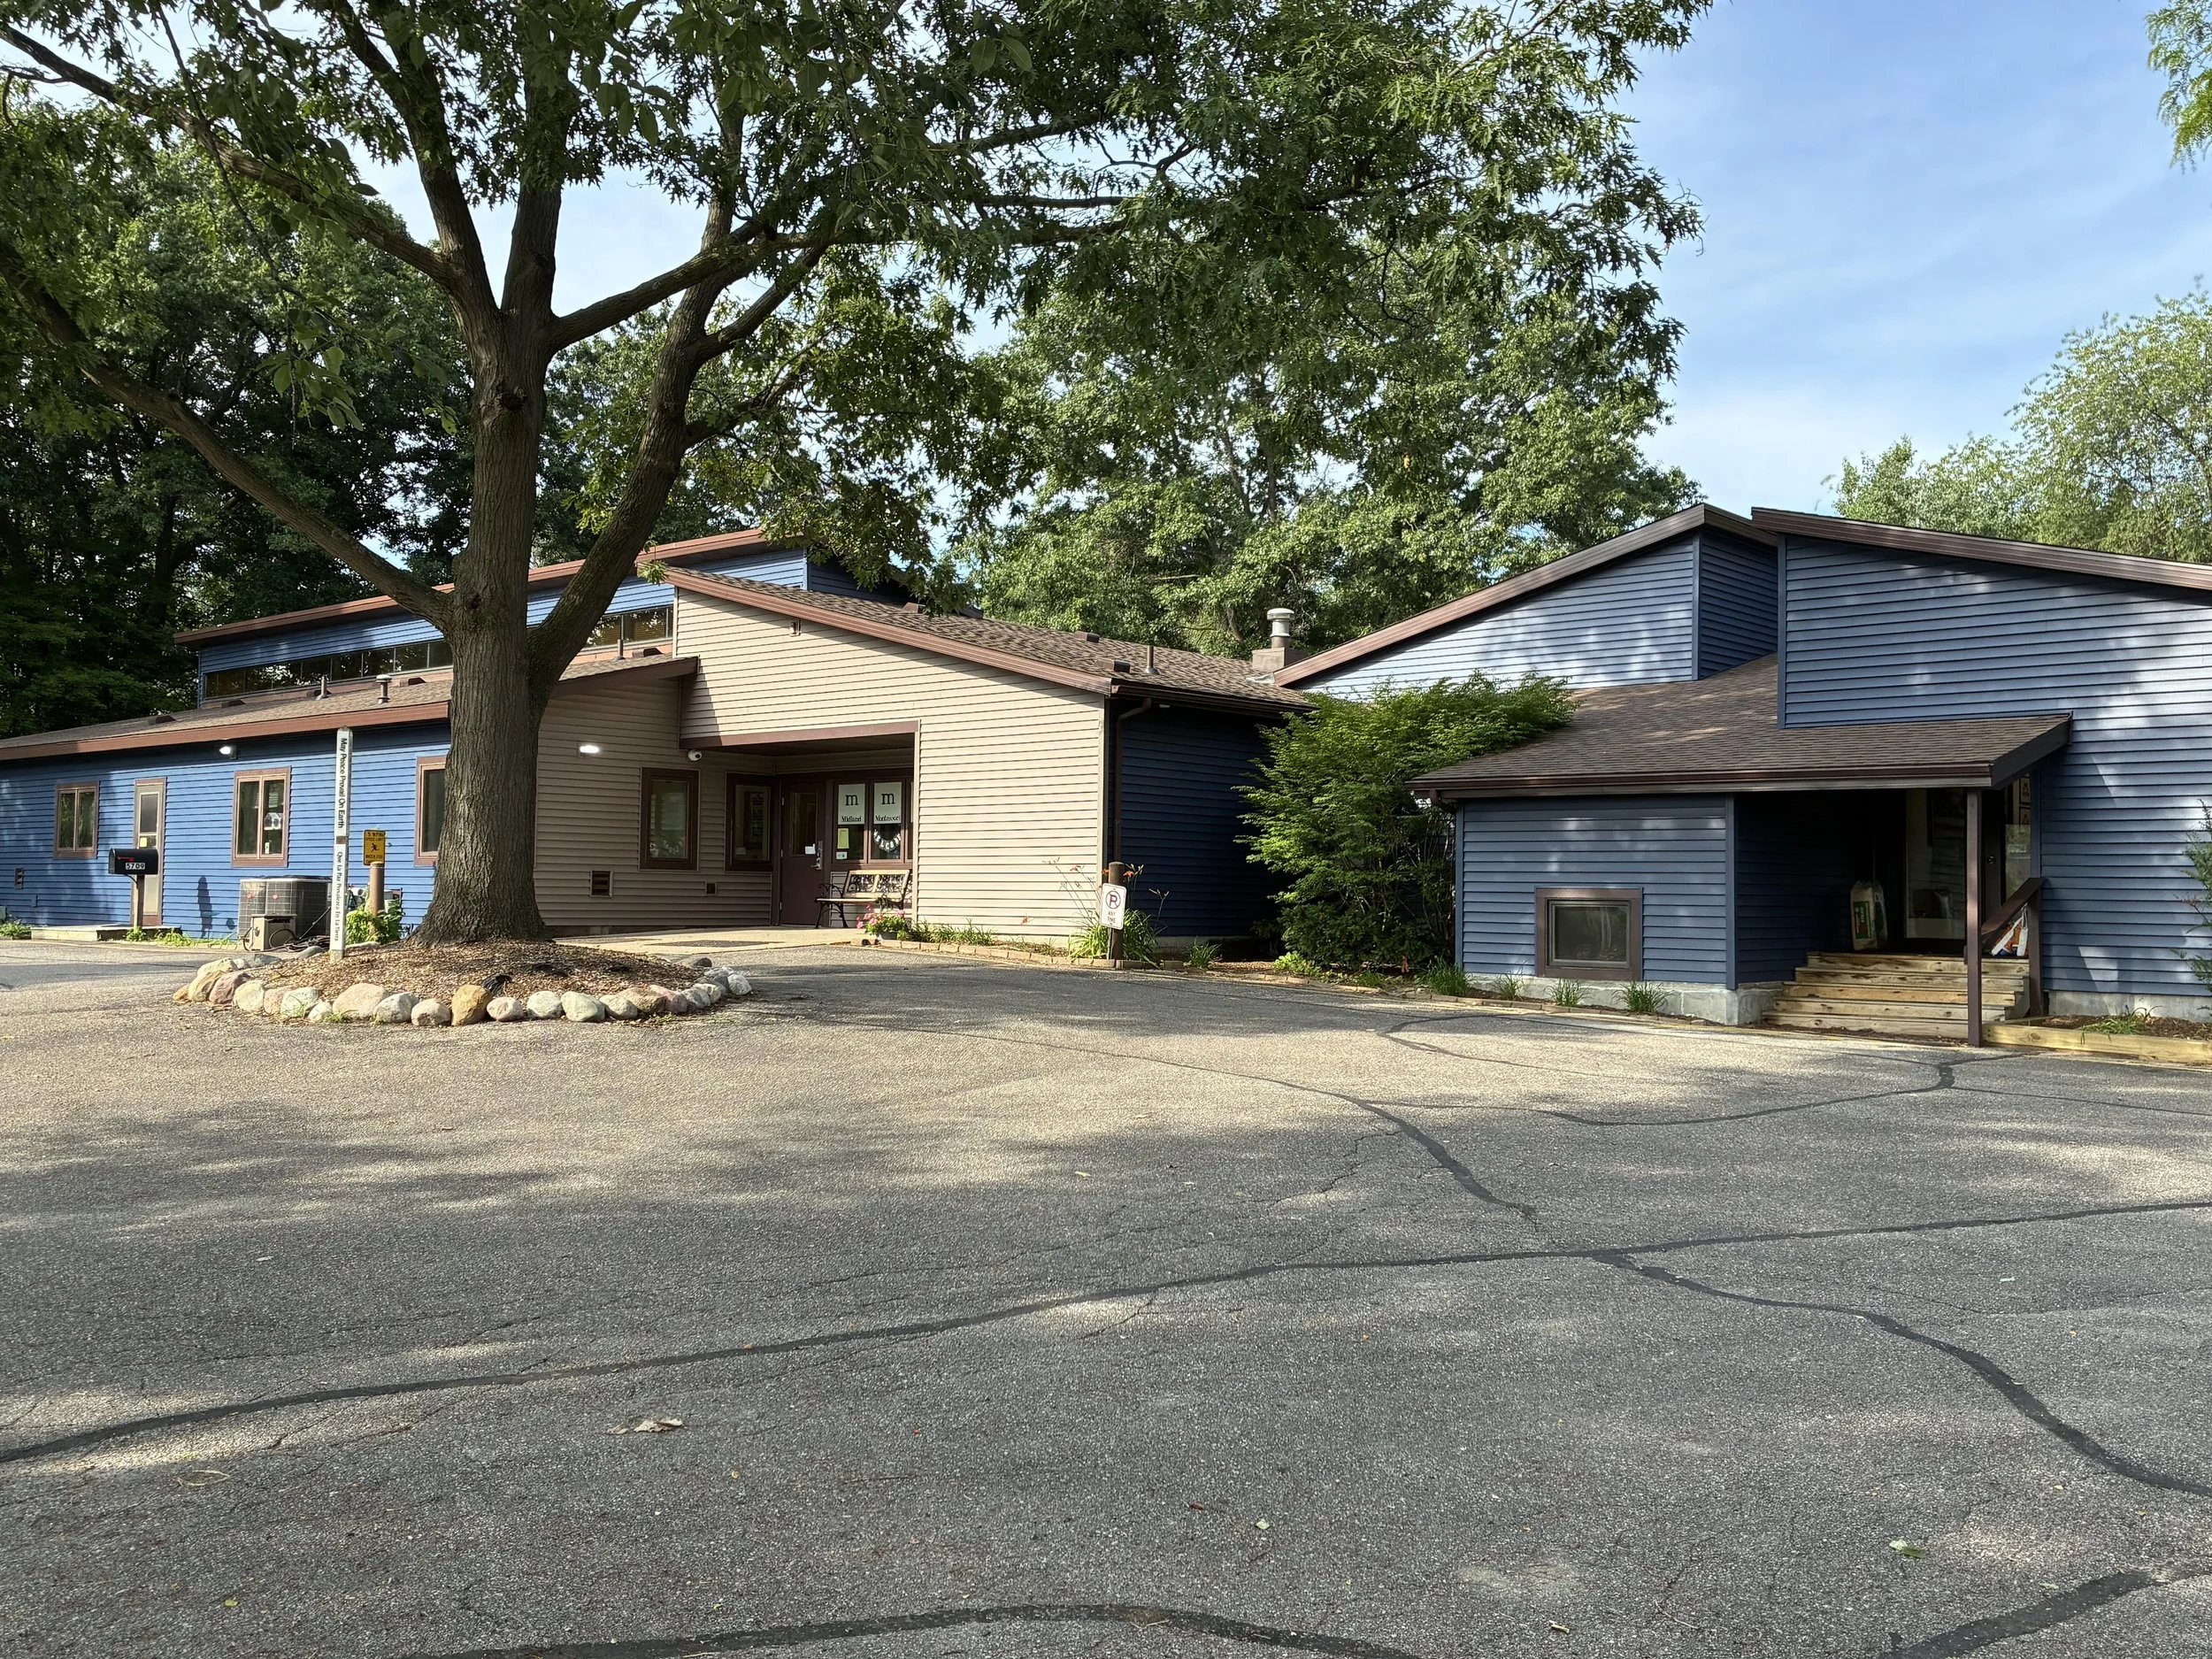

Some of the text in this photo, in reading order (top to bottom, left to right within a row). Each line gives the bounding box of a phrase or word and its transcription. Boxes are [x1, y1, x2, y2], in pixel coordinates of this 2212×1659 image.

[338, 797, 346, 809] On
[846, 795, 858, 806] m
[881, 793, 895, 805] m
